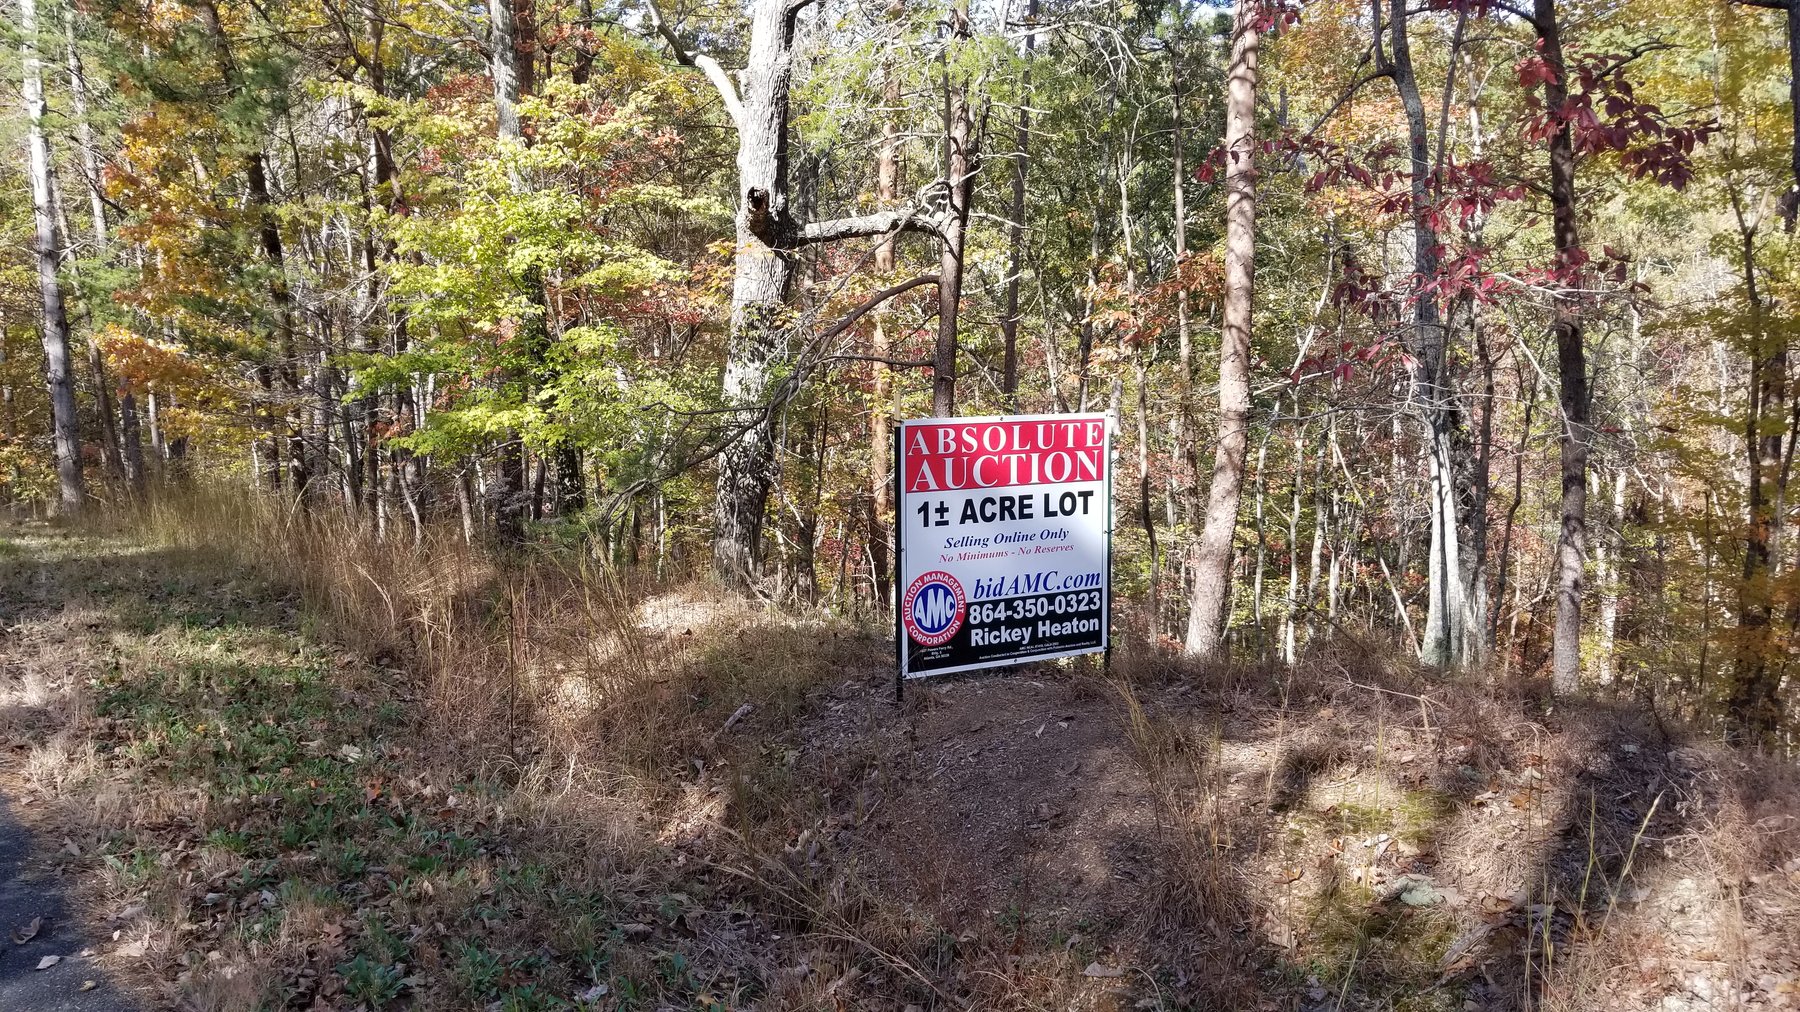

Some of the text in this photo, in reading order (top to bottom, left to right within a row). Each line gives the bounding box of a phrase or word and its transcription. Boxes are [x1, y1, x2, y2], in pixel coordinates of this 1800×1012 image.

[908, 422, 1103, 456] ABSOLUTE
[911, 450, 1101, 491] AUCTION
[959, 494, 1034, 525] ACRE
[1043, 490, 1094, 518] LOT
[939, 554, 954, 563] No
[956, 550, 1009, 562] Minimums
[1017, 547, 1032, 556] No
[1034, 543, 1075, 555] Reserves
[944, 527, 1070, 549] Selling Online Only
[904, 572, 965, 621] AUCTION MANAGEMENT
[973, 571, 1101, 599] bidAMC.com
[914, 588, 955, 629] AMC
[969, 591, 1101, 625] 864-350-0323
[909, 620, 960, 645] CORPORATION
[970, 625, 1032, 647] Rickey
[1037, 617, 1100, 639] Heaton
